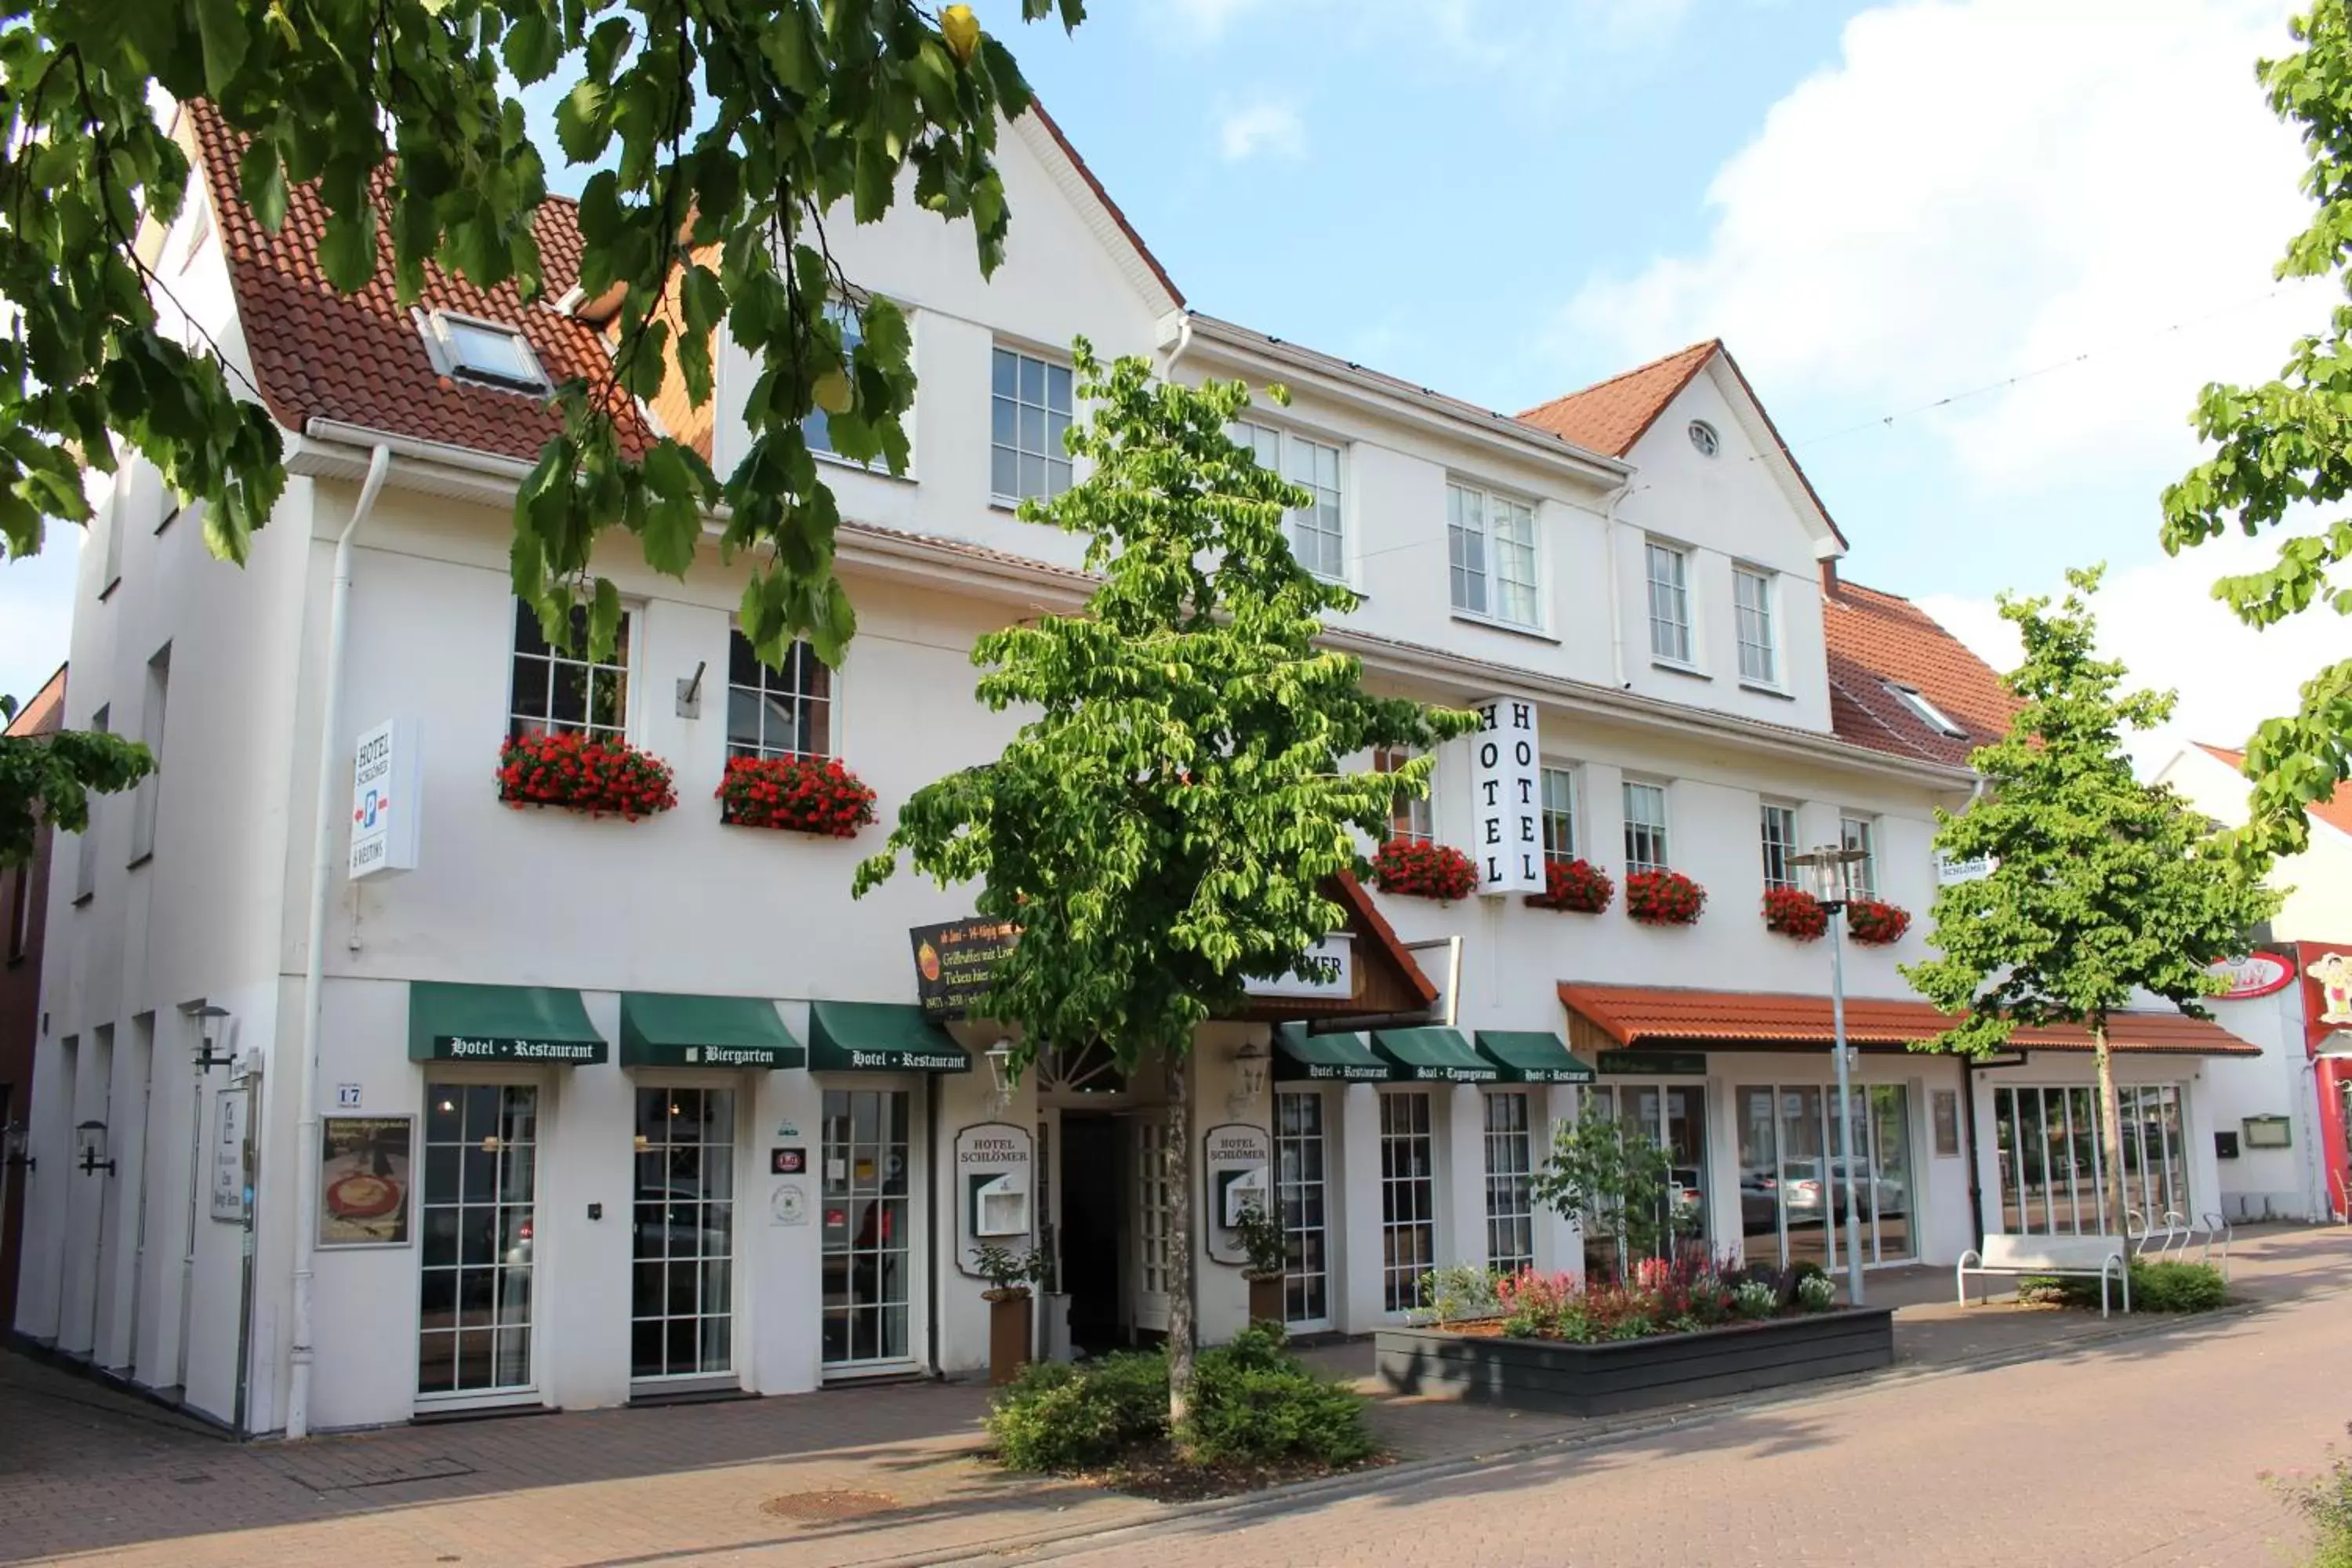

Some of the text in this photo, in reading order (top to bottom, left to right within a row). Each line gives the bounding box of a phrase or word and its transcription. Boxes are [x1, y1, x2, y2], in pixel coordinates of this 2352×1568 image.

[358, 732, 390, 768] HOTEL
[1479, 704, 1502, 883] HOTEL
[1512, 703, 1536, 880] HOTEL
[451, 1037, 593, 1058] Hotel Restaurant
[705, 1045, 774, 1064] Biergarten
[852, 1051, 965, 1068] Hotel Restaurant
[1344, 1065, 1388, 1077] Restaurant
[341, 1089, 359, 1102] 17
[974, 1139, 1015, 1149] HOTEL
[1220, 1138, 1255, 1149] HOTEL
